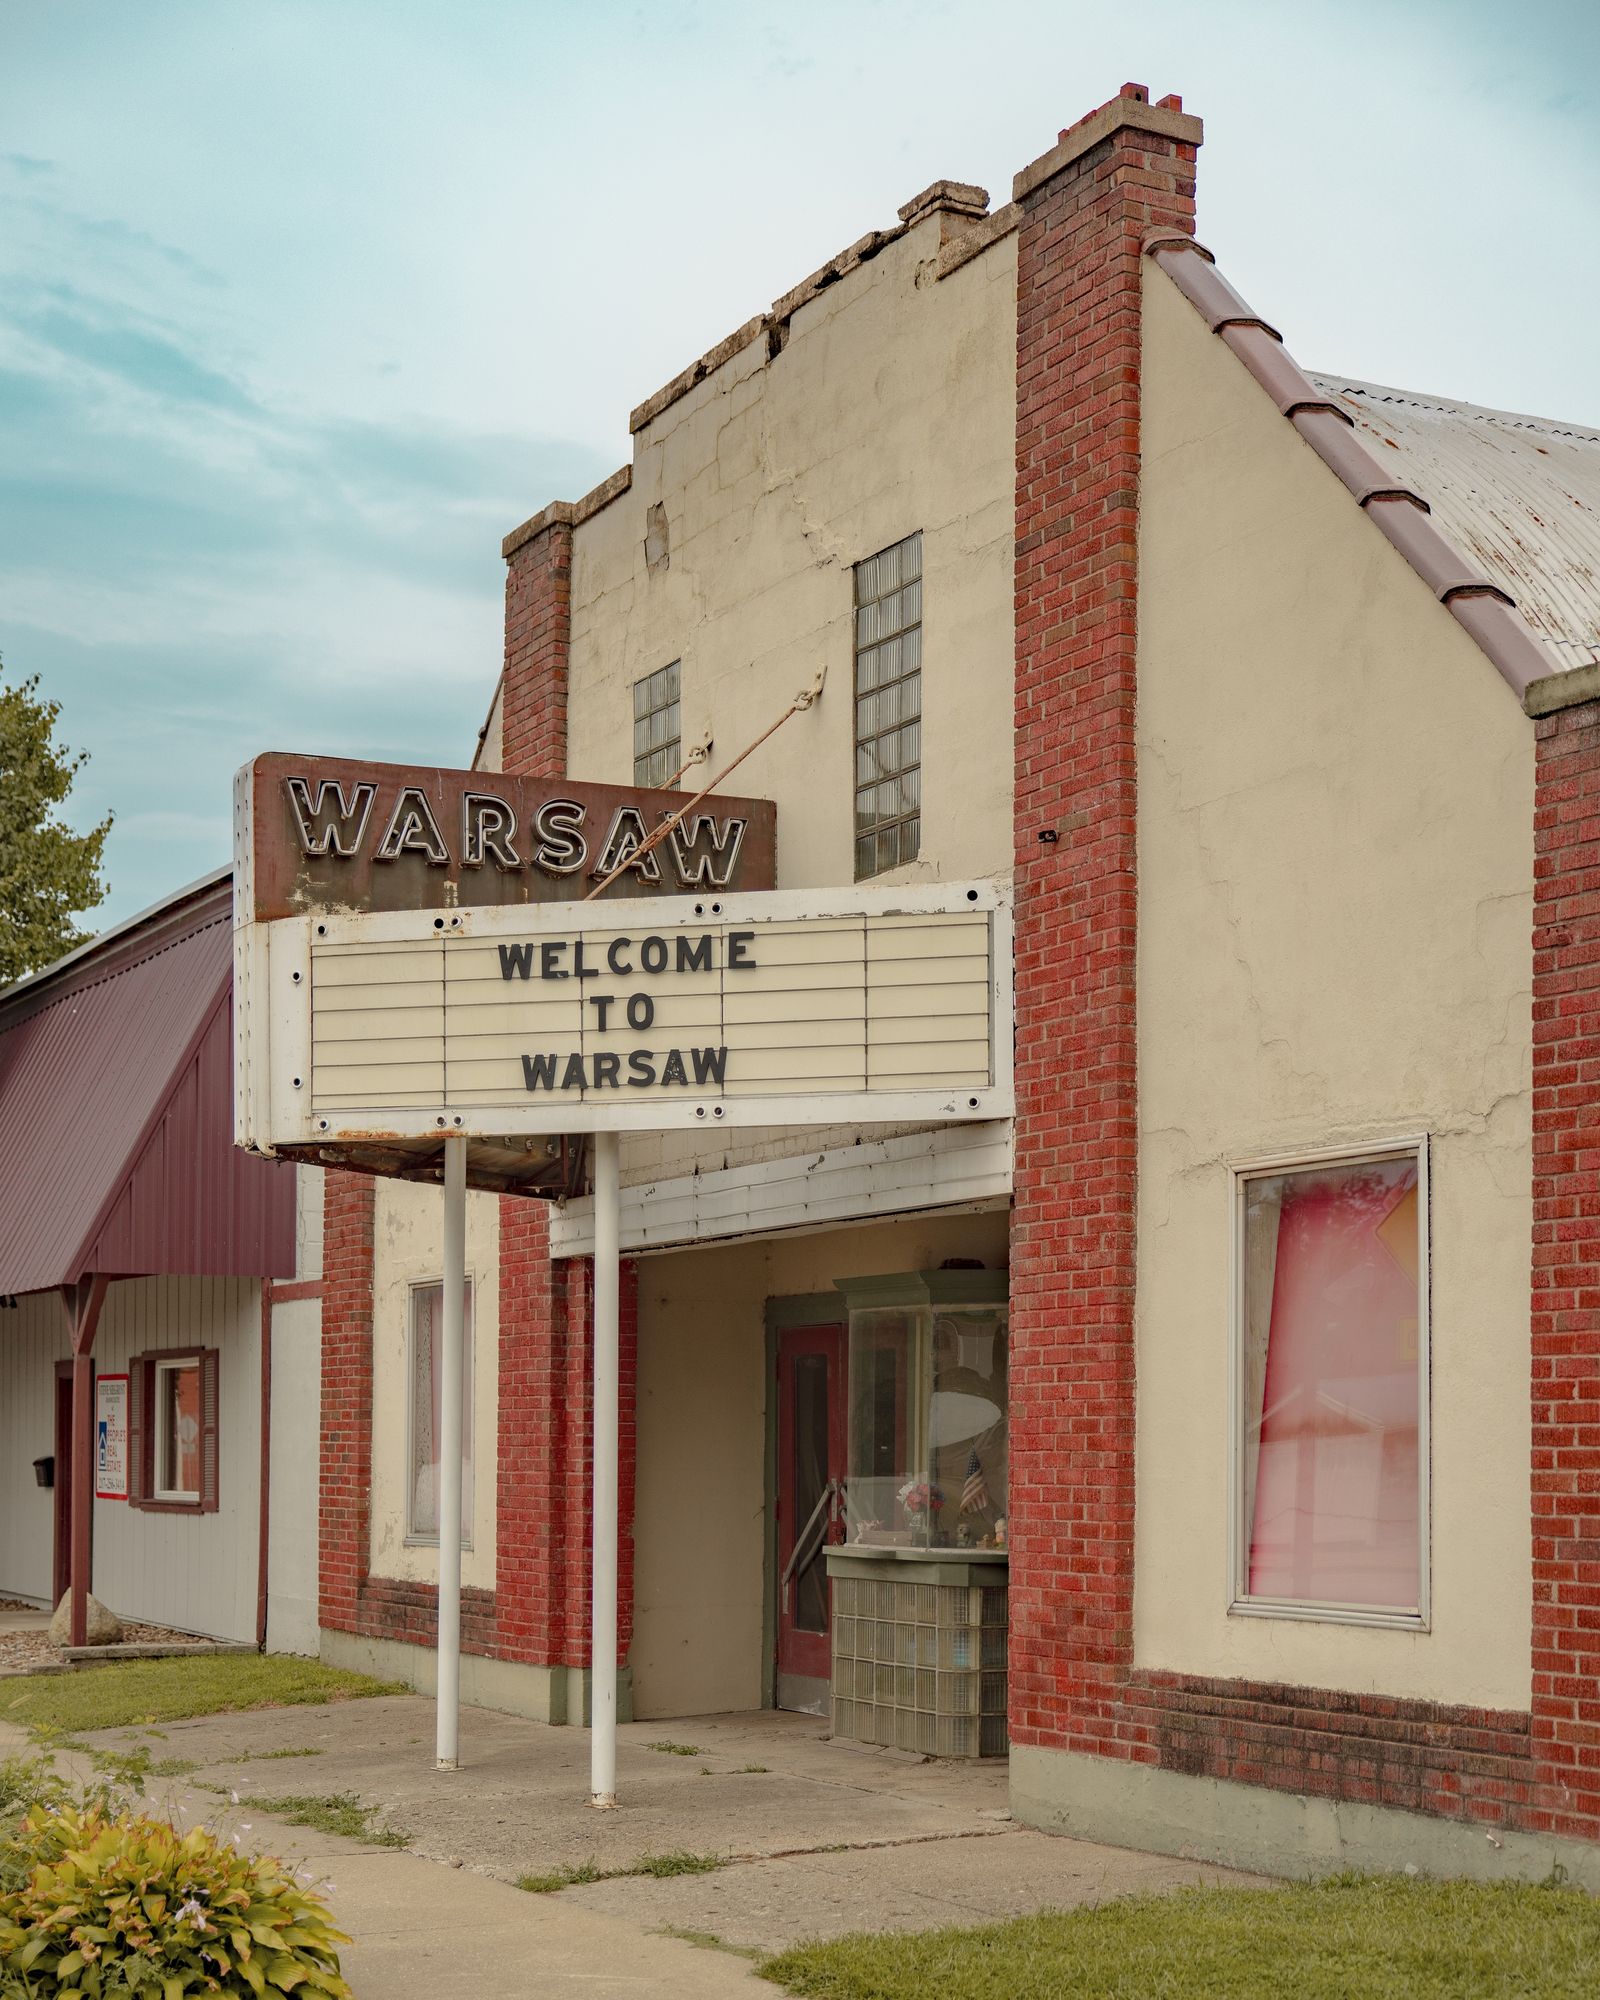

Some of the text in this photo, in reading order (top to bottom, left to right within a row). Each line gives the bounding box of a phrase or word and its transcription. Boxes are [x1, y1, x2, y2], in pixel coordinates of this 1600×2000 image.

[280, 776, 749, 887] WARSAW
[498, 932, 756, 980] WELCOME
[590, 993, 654, 1032] TO
[521, 1047, 727, 1091] WARSAW
[107, 1414, 115, 1427] THE
[107, 1445, 117, 1457] REAL
[107, 1460, 121, 1472] ESTATE
